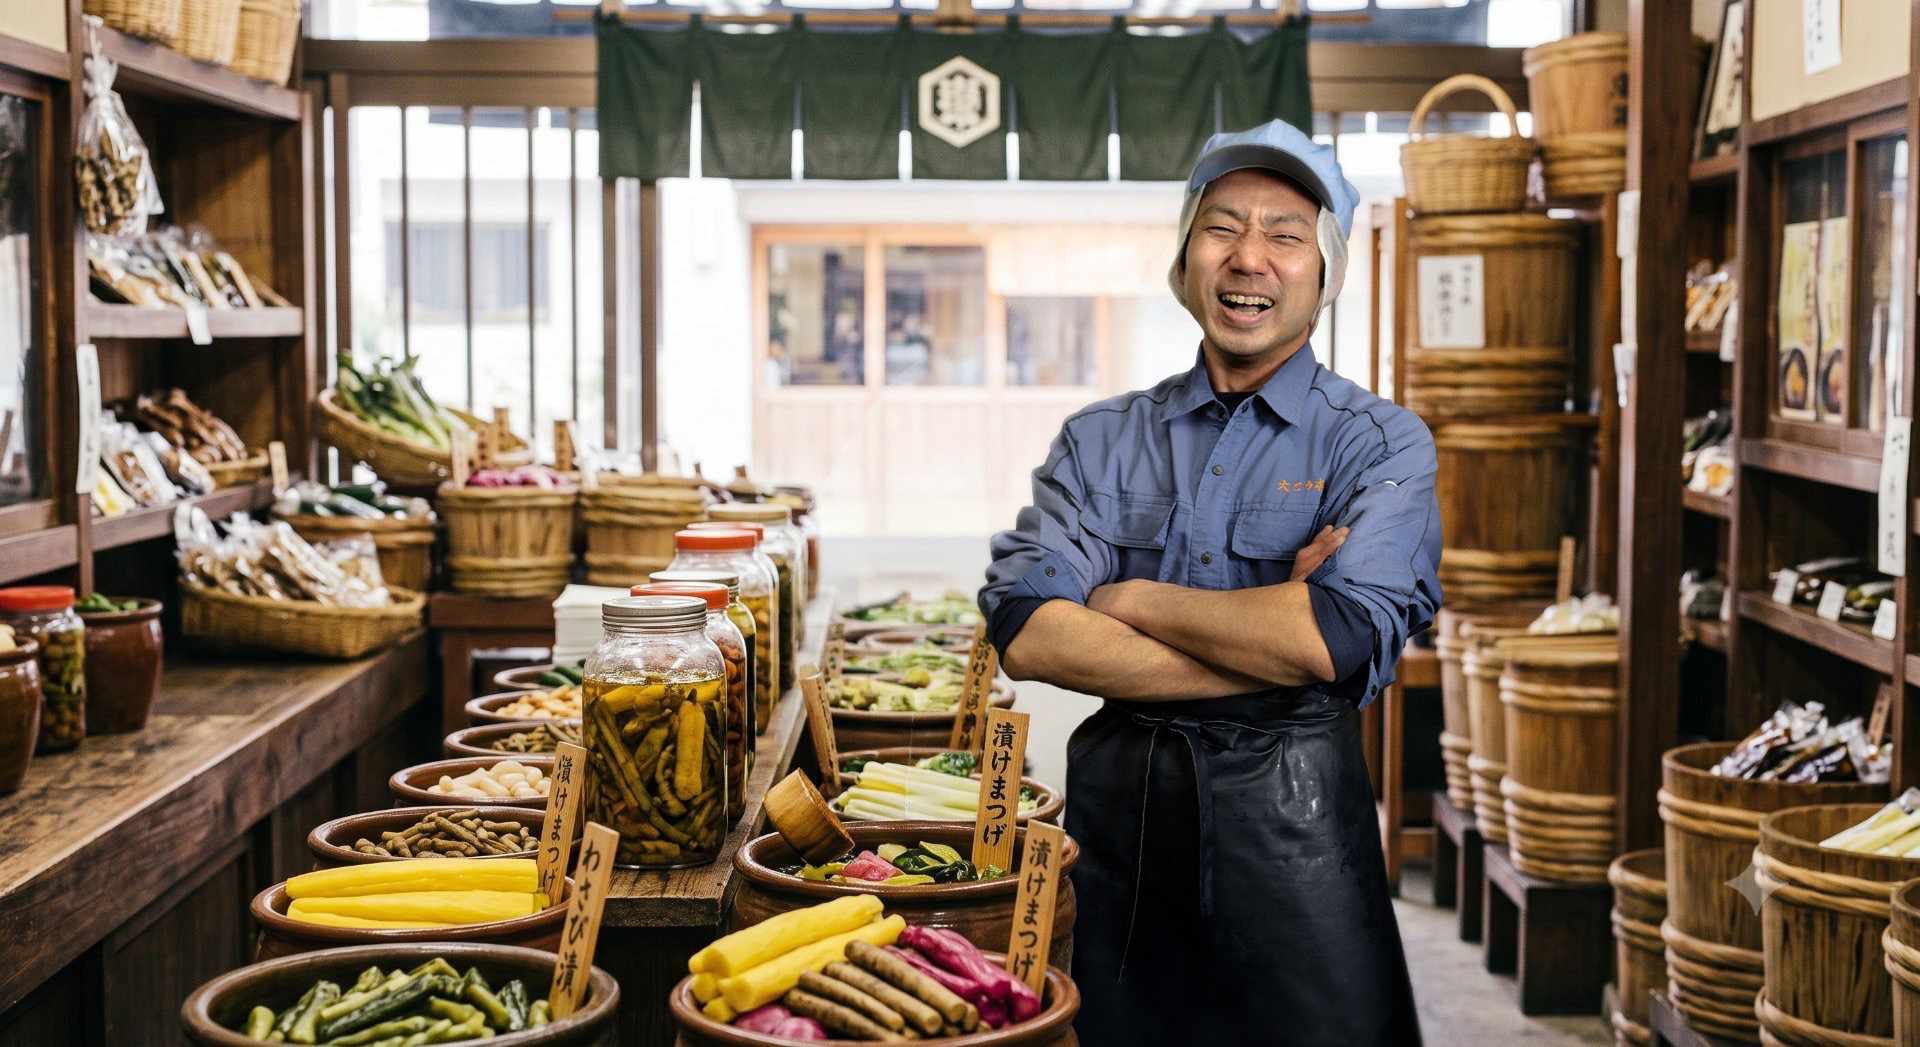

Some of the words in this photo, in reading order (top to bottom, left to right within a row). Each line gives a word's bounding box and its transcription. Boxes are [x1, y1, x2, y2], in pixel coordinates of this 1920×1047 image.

[984, 722, 1016, 846] 漬けまつげ
[1013, 839, 1051, 982] 漬けまつげ
